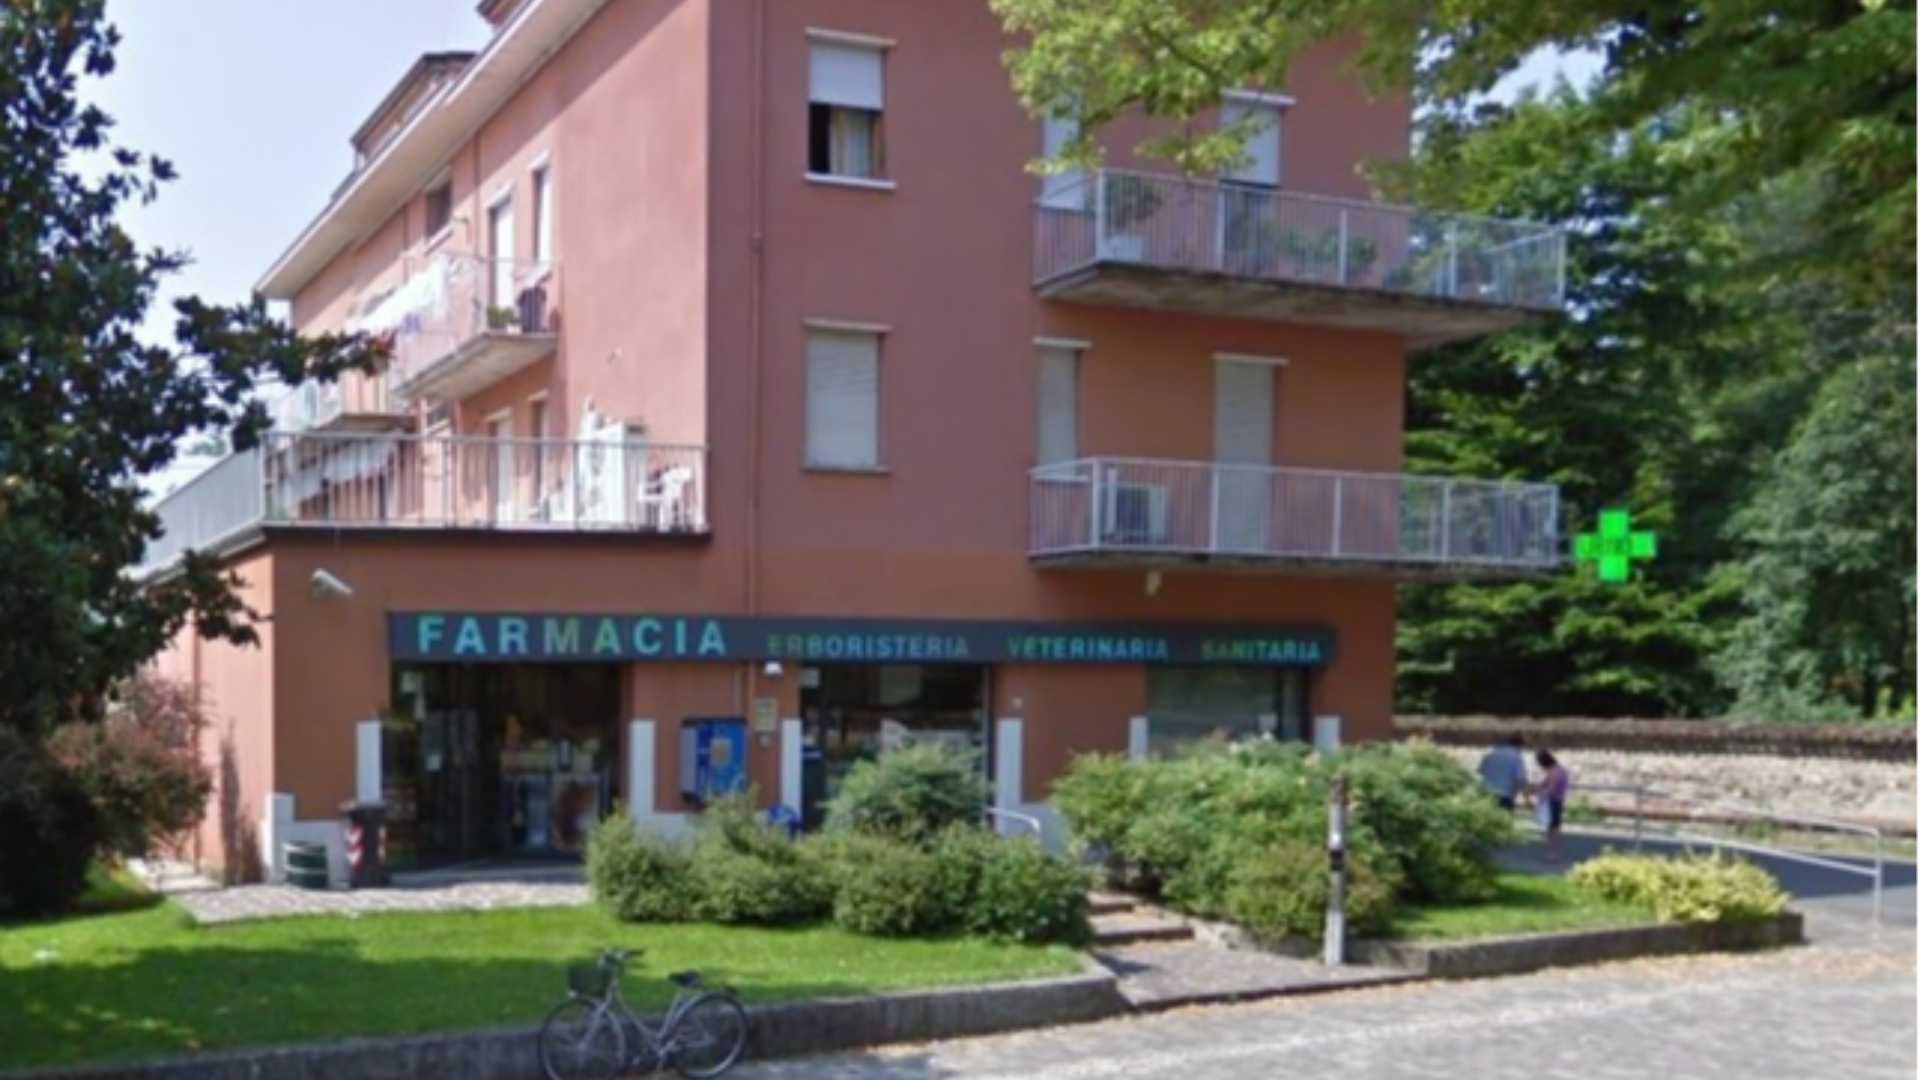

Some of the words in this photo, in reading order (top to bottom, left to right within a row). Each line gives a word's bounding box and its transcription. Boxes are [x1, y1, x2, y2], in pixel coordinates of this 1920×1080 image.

[418, 616, 727, 655] FARMACIA
[767, 634, 969, 659] ERBORISTERIA
[1008, 637, 1168, 661] VETERINARIA
[1201, 639, 1321, 662] SANITARIA
